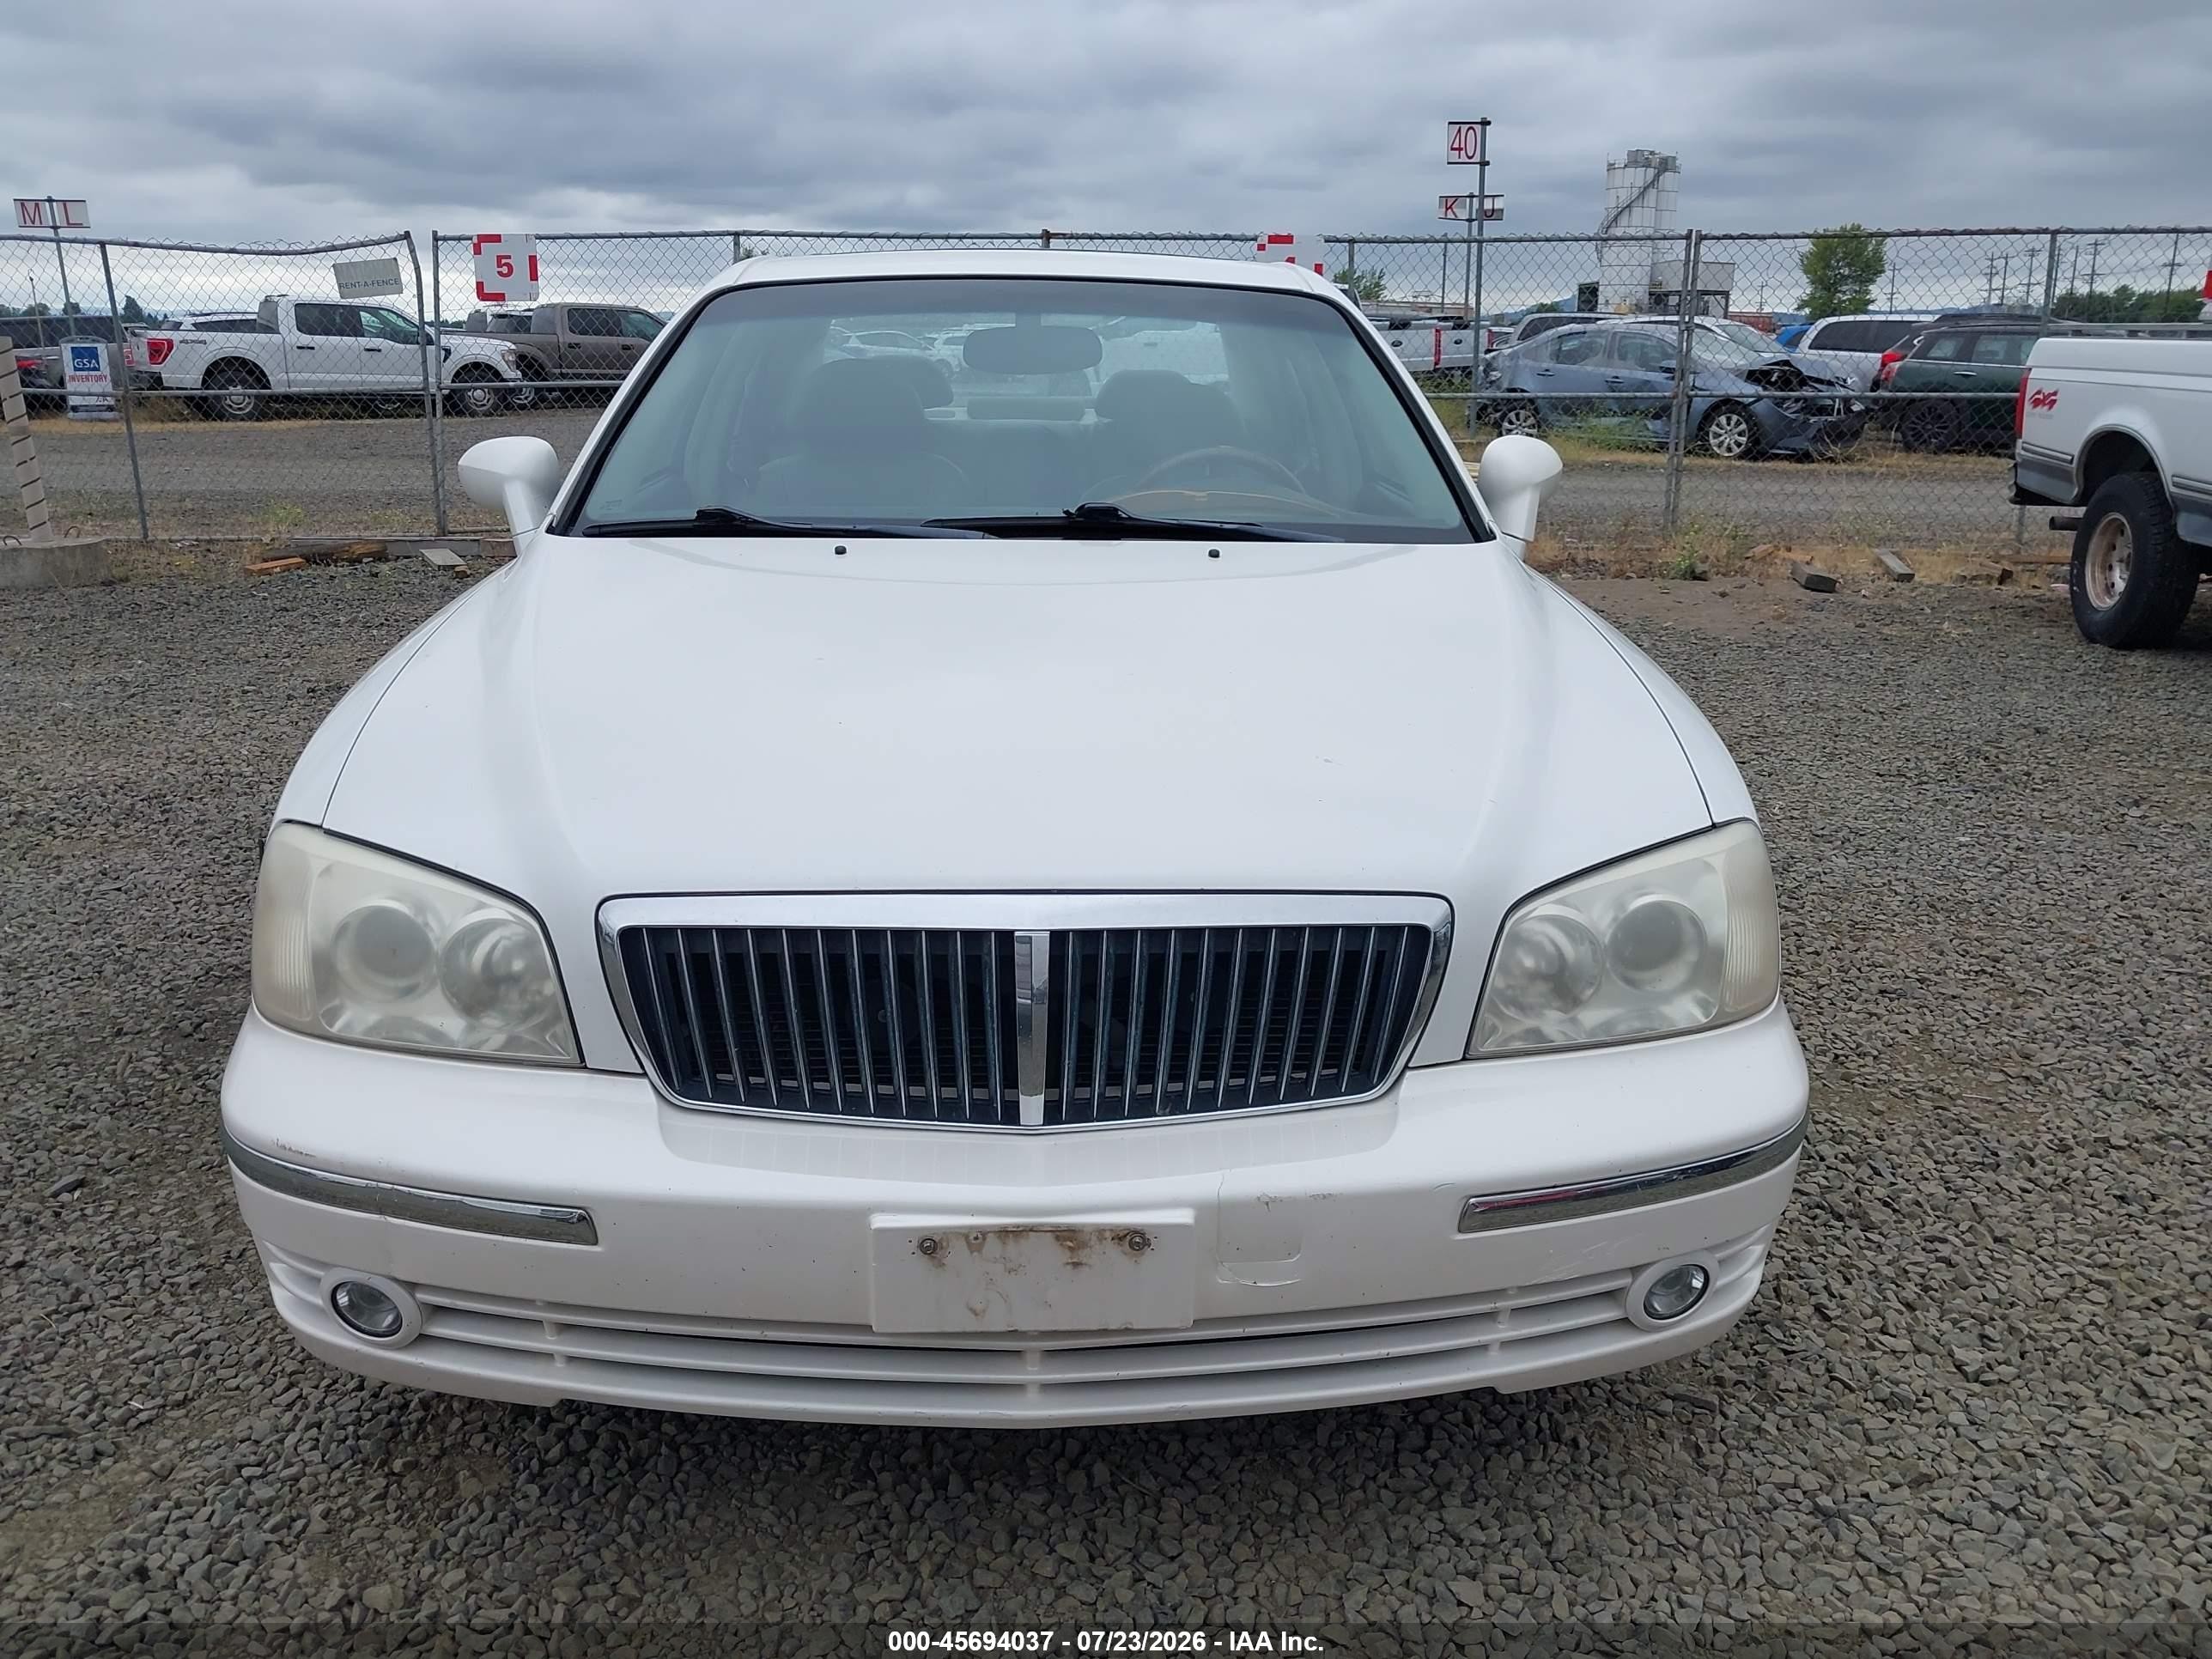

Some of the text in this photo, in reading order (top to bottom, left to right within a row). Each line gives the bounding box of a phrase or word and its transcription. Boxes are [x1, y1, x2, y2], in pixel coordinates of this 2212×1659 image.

[1449, 125, 1478, 161] 40
[20, 201, 84, 227] M L
[1443, 198, 1496, 219] K J
[495, 254, 514, 278] 5
[338, 277, 400, 290] RENT-A-FENCE
[74, 358, 100, 369] GSA
[69, 374, 108, 384] INVENTORY
